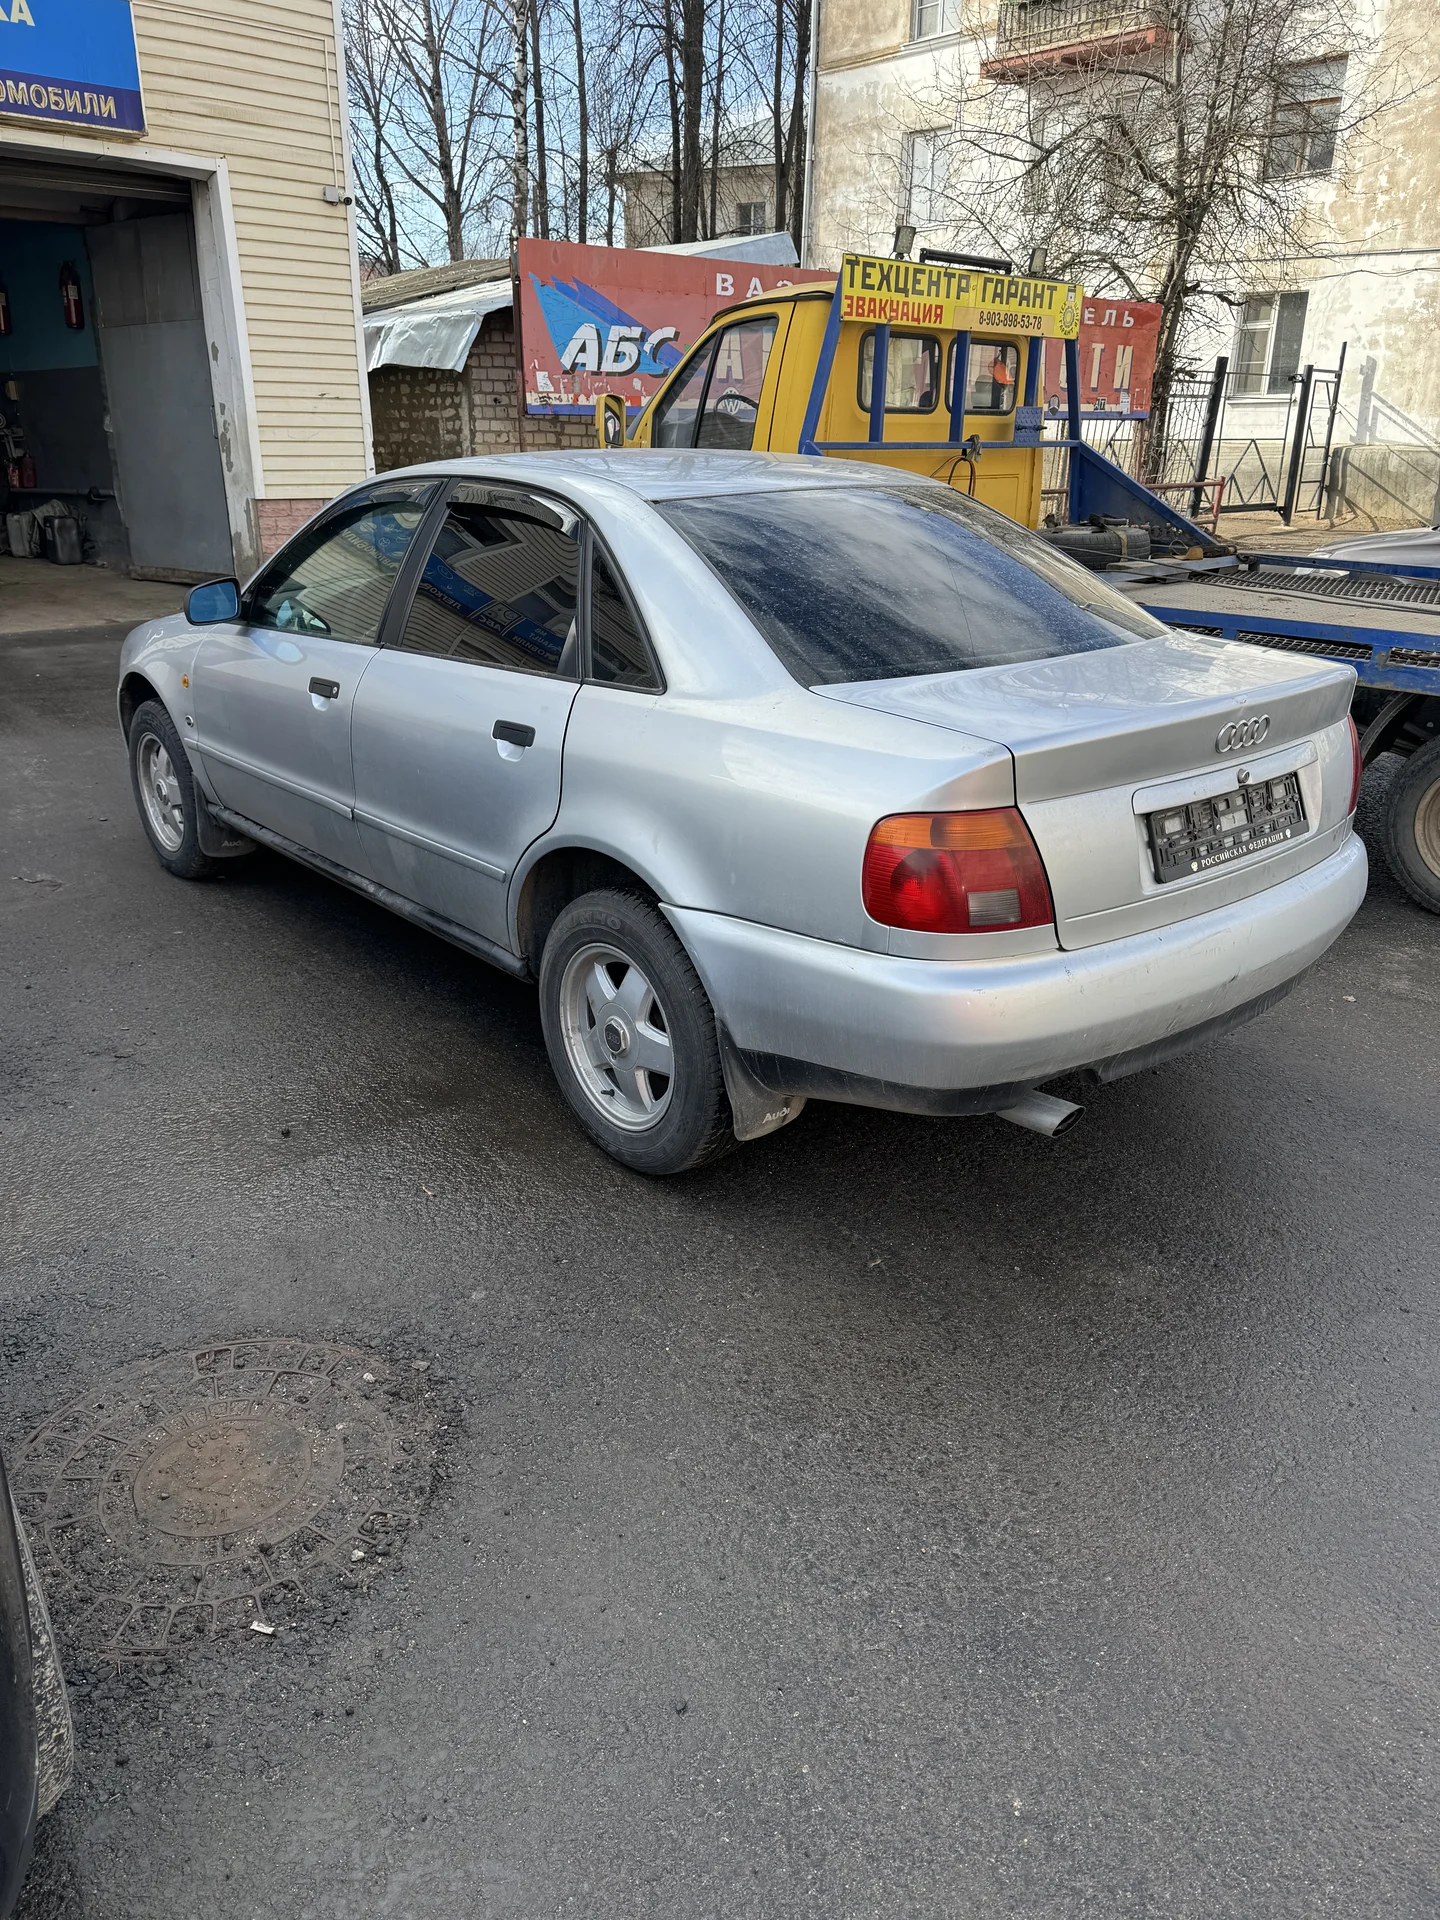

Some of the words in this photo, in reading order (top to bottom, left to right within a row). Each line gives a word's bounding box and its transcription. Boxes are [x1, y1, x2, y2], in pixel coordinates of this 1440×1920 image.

[0, 0, 35, 26] А
[845, 258, 971, 300] ТЕХЦЕНТР
[982, 276, 1058, 310] ГАРАНТ
[843, 294, 944, 325] ЭВАКУАЦИЯ
[979, 310, 1043, 331] 8-903-898-53-78
[1084, 307, 1135, 328] ЕЛЬ
[560, 323, 679, 377] АБС
[1201, 846, 1247, 868] РОССИЙСКАЯ
[1248, 832, 1284, 851] ФЕДЕРАЦИЯ
[762, 1107, 790, 1124] Audi
